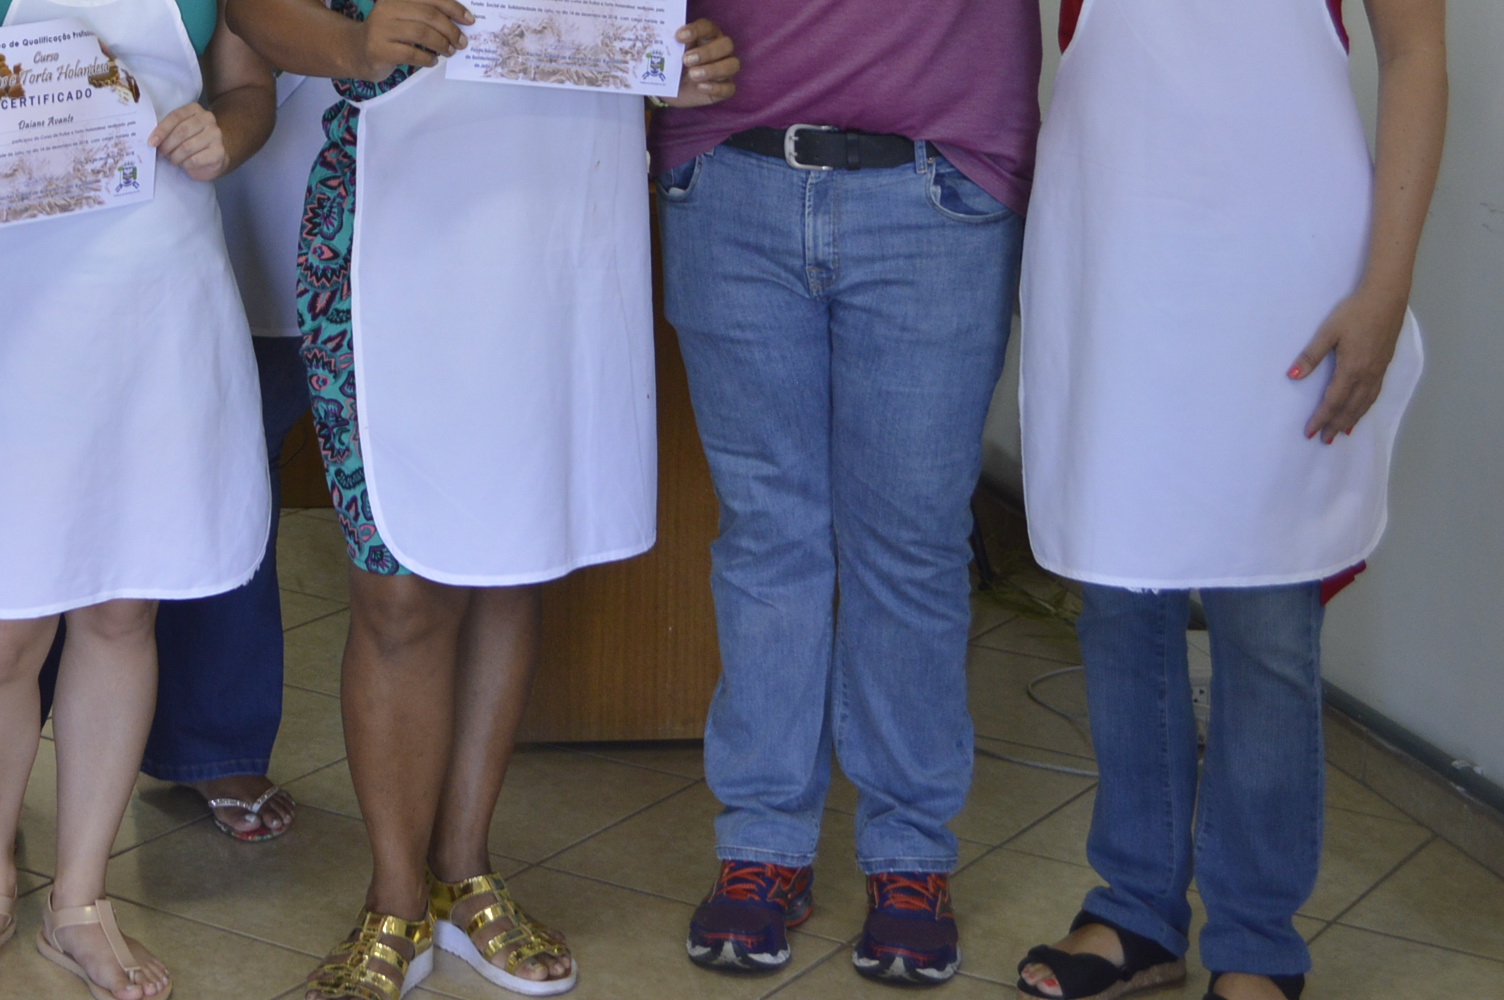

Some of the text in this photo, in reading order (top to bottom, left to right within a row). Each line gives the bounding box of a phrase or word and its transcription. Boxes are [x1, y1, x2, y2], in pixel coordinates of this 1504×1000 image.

[8, 38, 19, 48] de
[21, 31, 71, 47] Qualificação
[31, 48, 60, 64] Curso
[9, 75, 17, 86] e
[19, 65, 54, 86] Torta
[54, 55, 111, 81] Holandesa
[0, 86, 93, 111] CERTIFICADO
